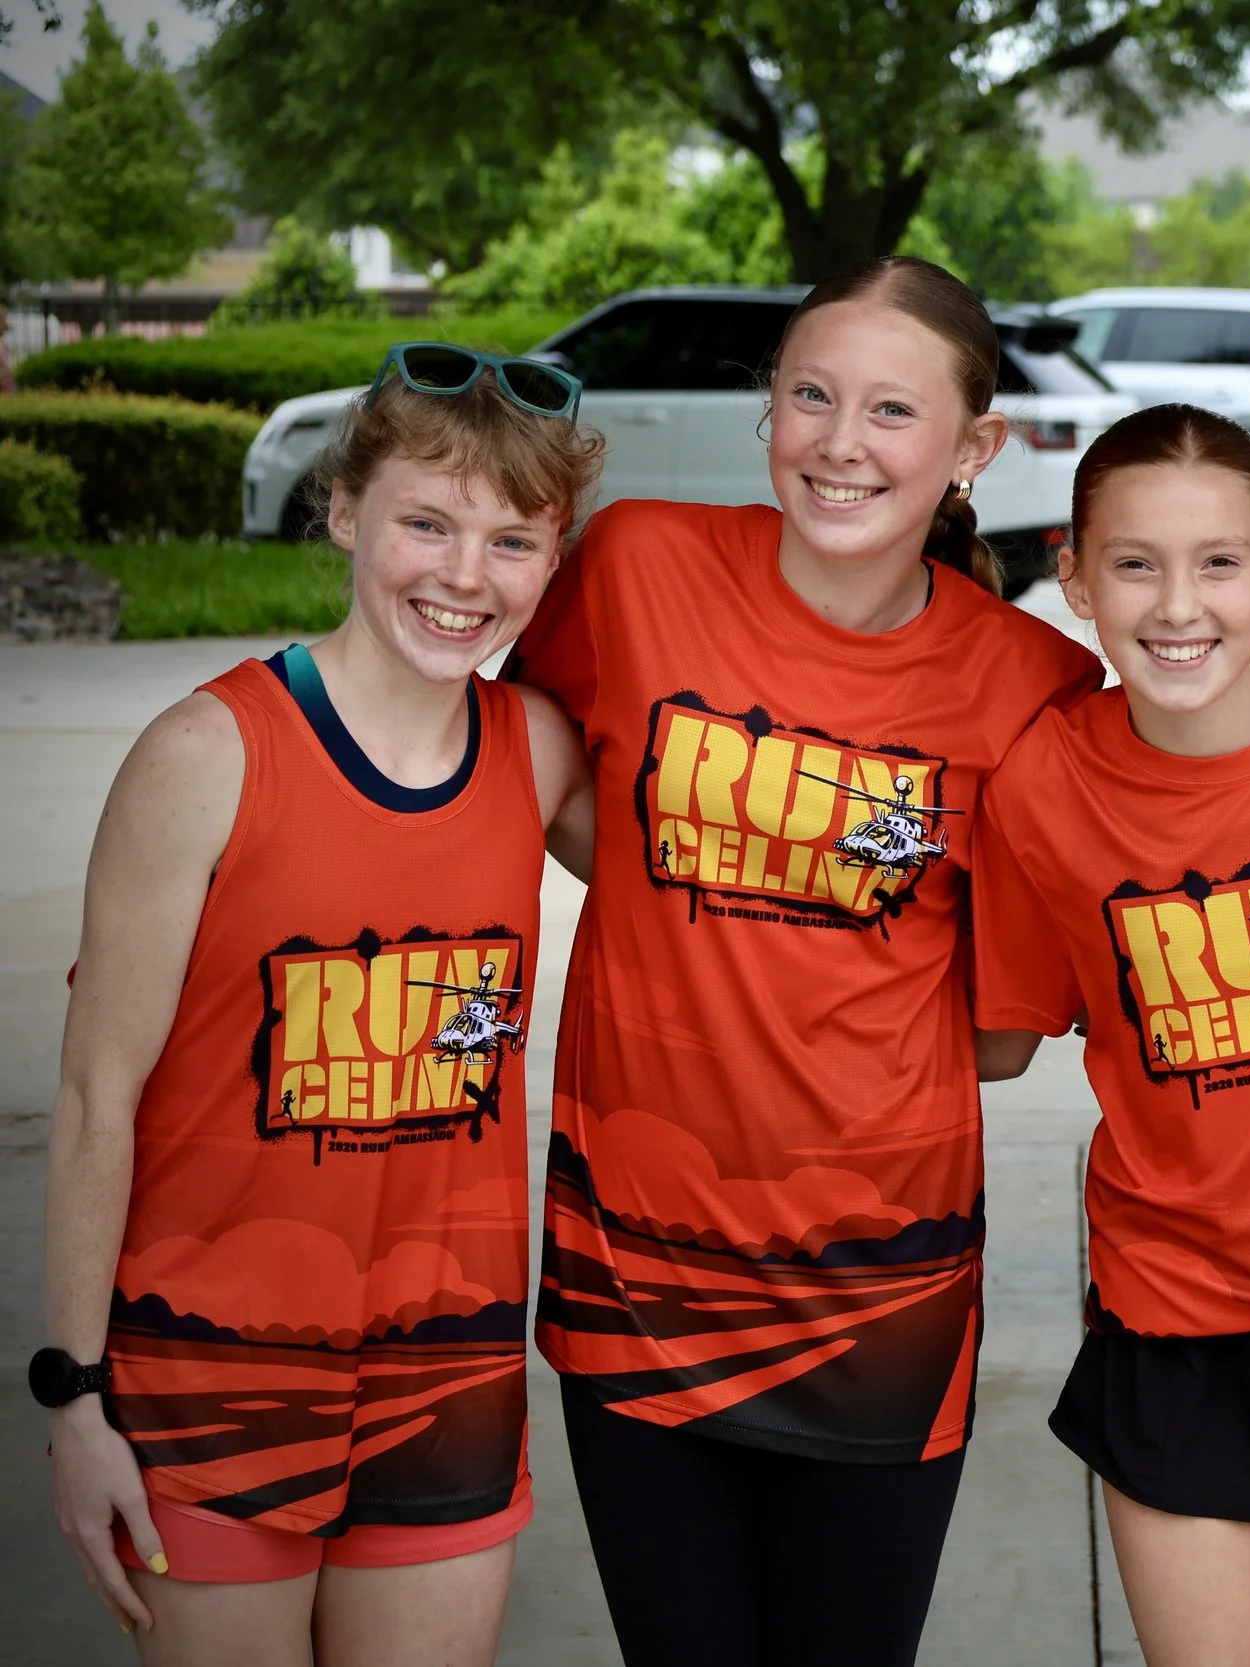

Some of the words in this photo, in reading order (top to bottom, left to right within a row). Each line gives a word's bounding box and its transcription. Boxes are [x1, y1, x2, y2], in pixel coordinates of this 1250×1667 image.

[657, 714, 930, 841] RUN
[657, 818, 904, 911] CELINA
[283, 948, 510, 1062] RUN
[1203, 1078, 1234, 1094] 2026
